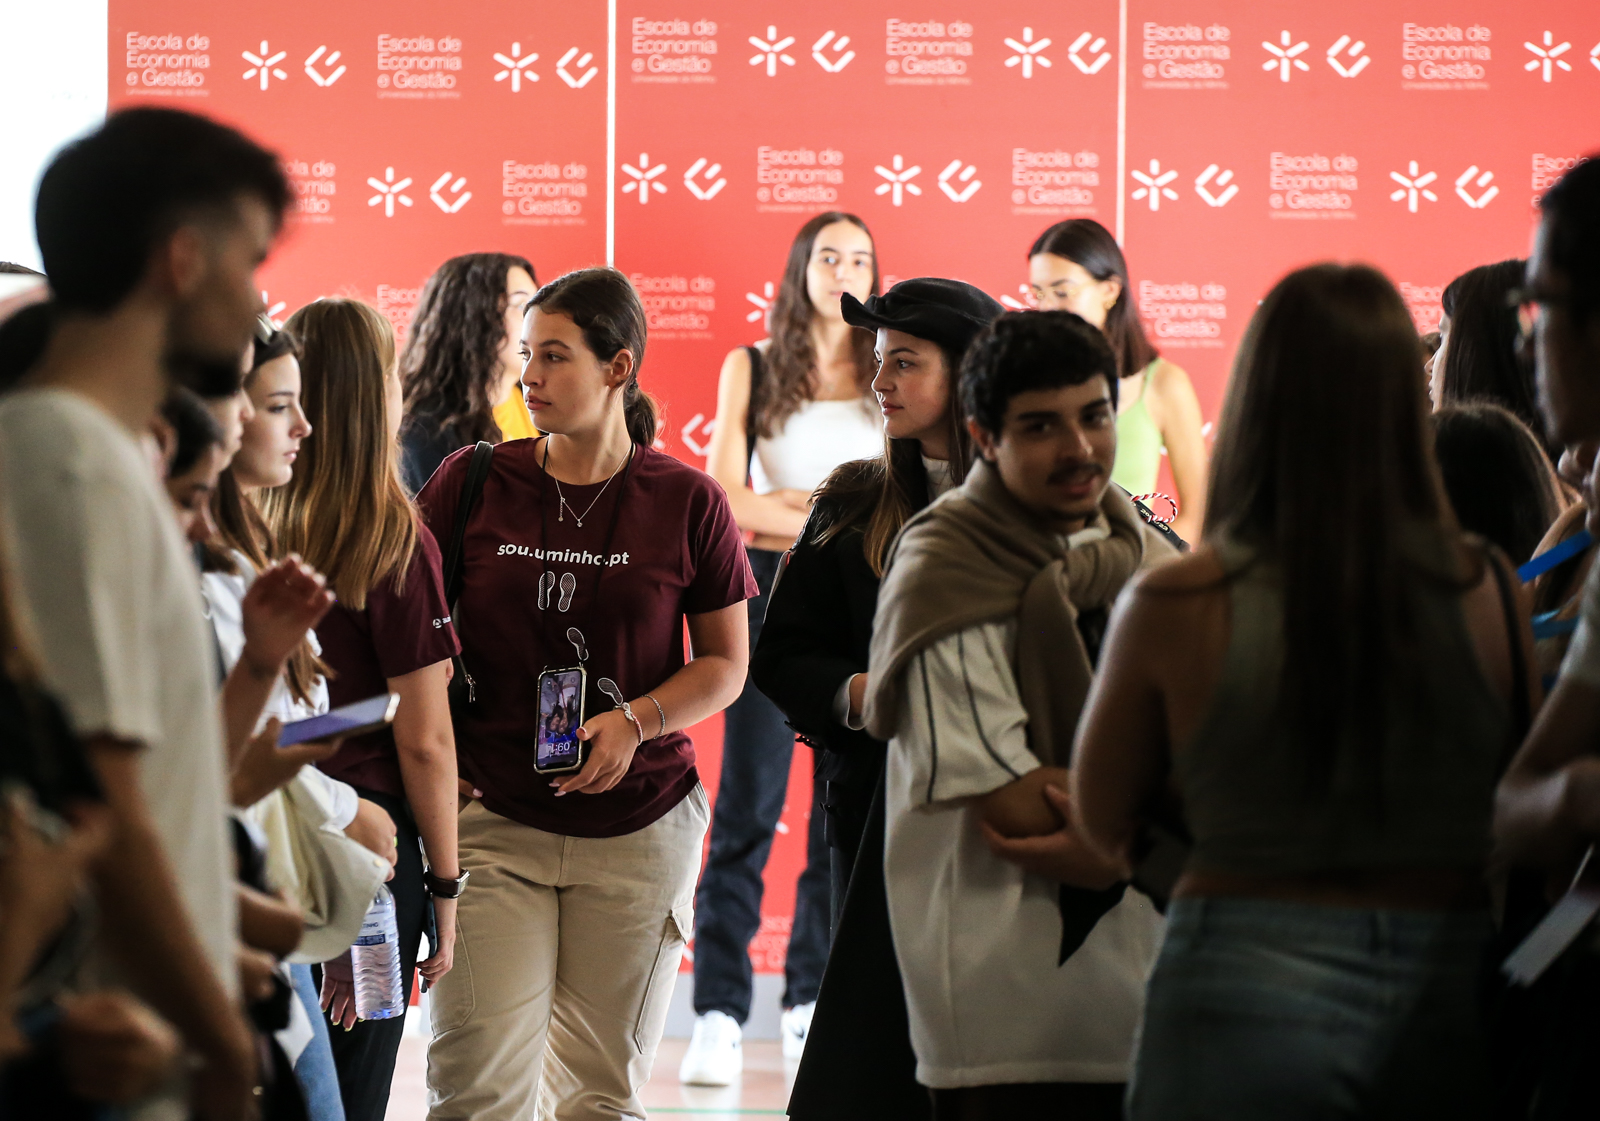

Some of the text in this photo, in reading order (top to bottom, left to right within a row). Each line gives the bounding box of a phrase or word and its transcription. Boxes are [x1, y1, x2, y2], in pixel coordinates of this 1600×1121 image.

[633, 18, 717, 35] Escola de
[887, 19, 973, 37] Escola de
[1144, 23, 1230, 40] Escola de
[1403, 24, 1491, 41] Escola de
[127, 33, 209, 50] Escola de
[378, 35, 461, 52] Escola de
[633, 36, 717, 54] Economia
[887, 38, 972, 55] Economia
[1144, 41, 1230, 59] Economia
[127, 50, 209, 68] Economia
[1403, 42, 1491, 60] Economia
[378, 52, 462, 70] Economia
[632, 55, 711, 72] e Gestão
[886, 56, 966, 74] e Gestão
[1143, 60, 1224, 78] e Gestão
[1402, 61, 1485, 78] e Gestão
[127, 69, 204, 86] e Gestão
[378, 71, 456, 88] e Gestão
[758, 147, 843, 165] Escola de
[1013, 149, 1099, 167] Escola de
[1271, 153, 1358, 171] Escola de
[313, 160, 335, 177] de
[503, 161, 586, 178] Escola de
[758, 165, 843, 183] Economia
[1013, 167, 1099, 185] Economia
[503, 179, 587, 196] Economia
[1270, 171, 1357, 189] Economia
[757, 184, 837, 202] e Gestão
[1012, 186, 1093, 204] e Gestão
[1270, 190, 1351, 209] e Gestão
[502, 197, 581, 215] e Gestão
[690, 274, 715, 292] de
[1140, 280, 1226, 299] Escola de
[1400, 283, 1442, 301] Esco
[378, 285, 421, 303] Esco
[1140, 300, 1226, 318] Economia
